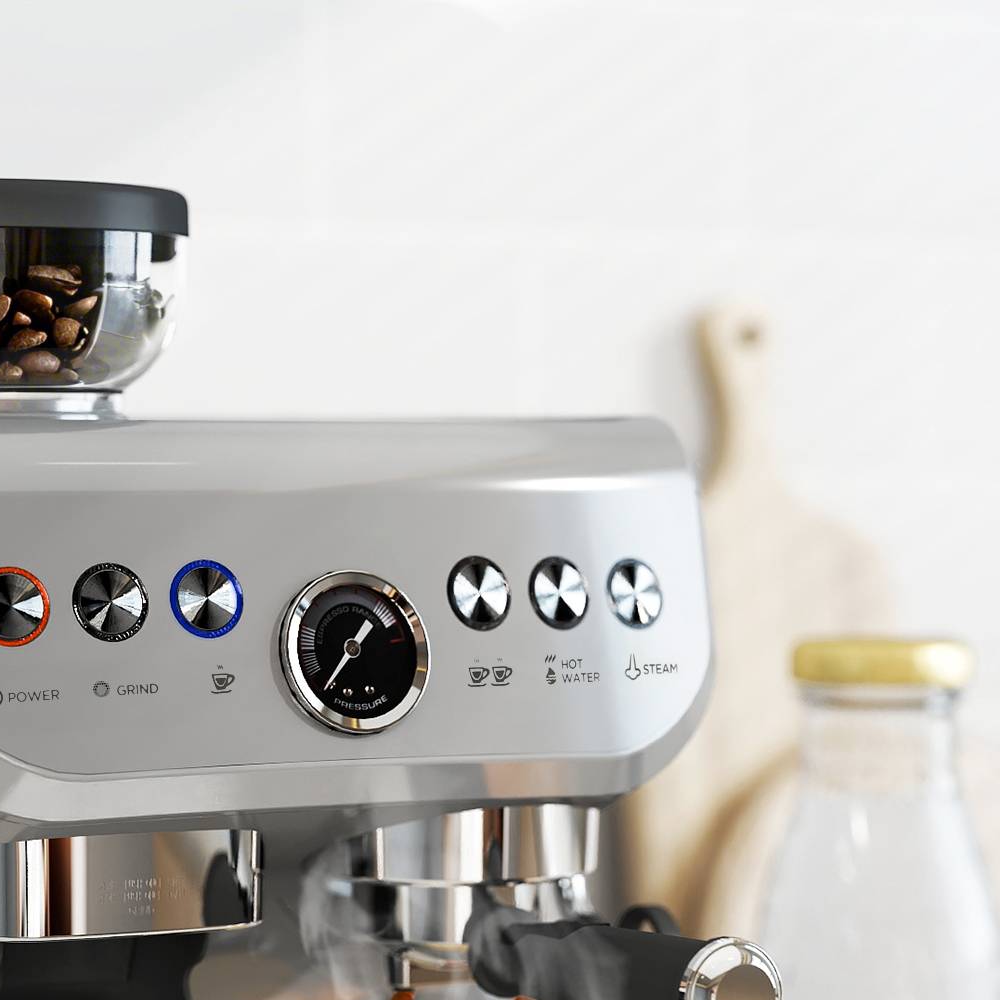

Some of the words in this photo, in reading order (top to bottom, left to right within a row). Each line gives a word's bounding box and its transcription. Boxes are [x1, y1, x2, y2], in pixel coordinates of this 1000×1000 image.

[561, 658, 583, 670] HOT
[643, 663, 679, 675] STEAM
[561, 672, 601, 684] WATER
[116, 683, 159, 696] GRIND
[8, 689, 60, 703] POWER
[333, 694, 389, 711] PRESSURE
